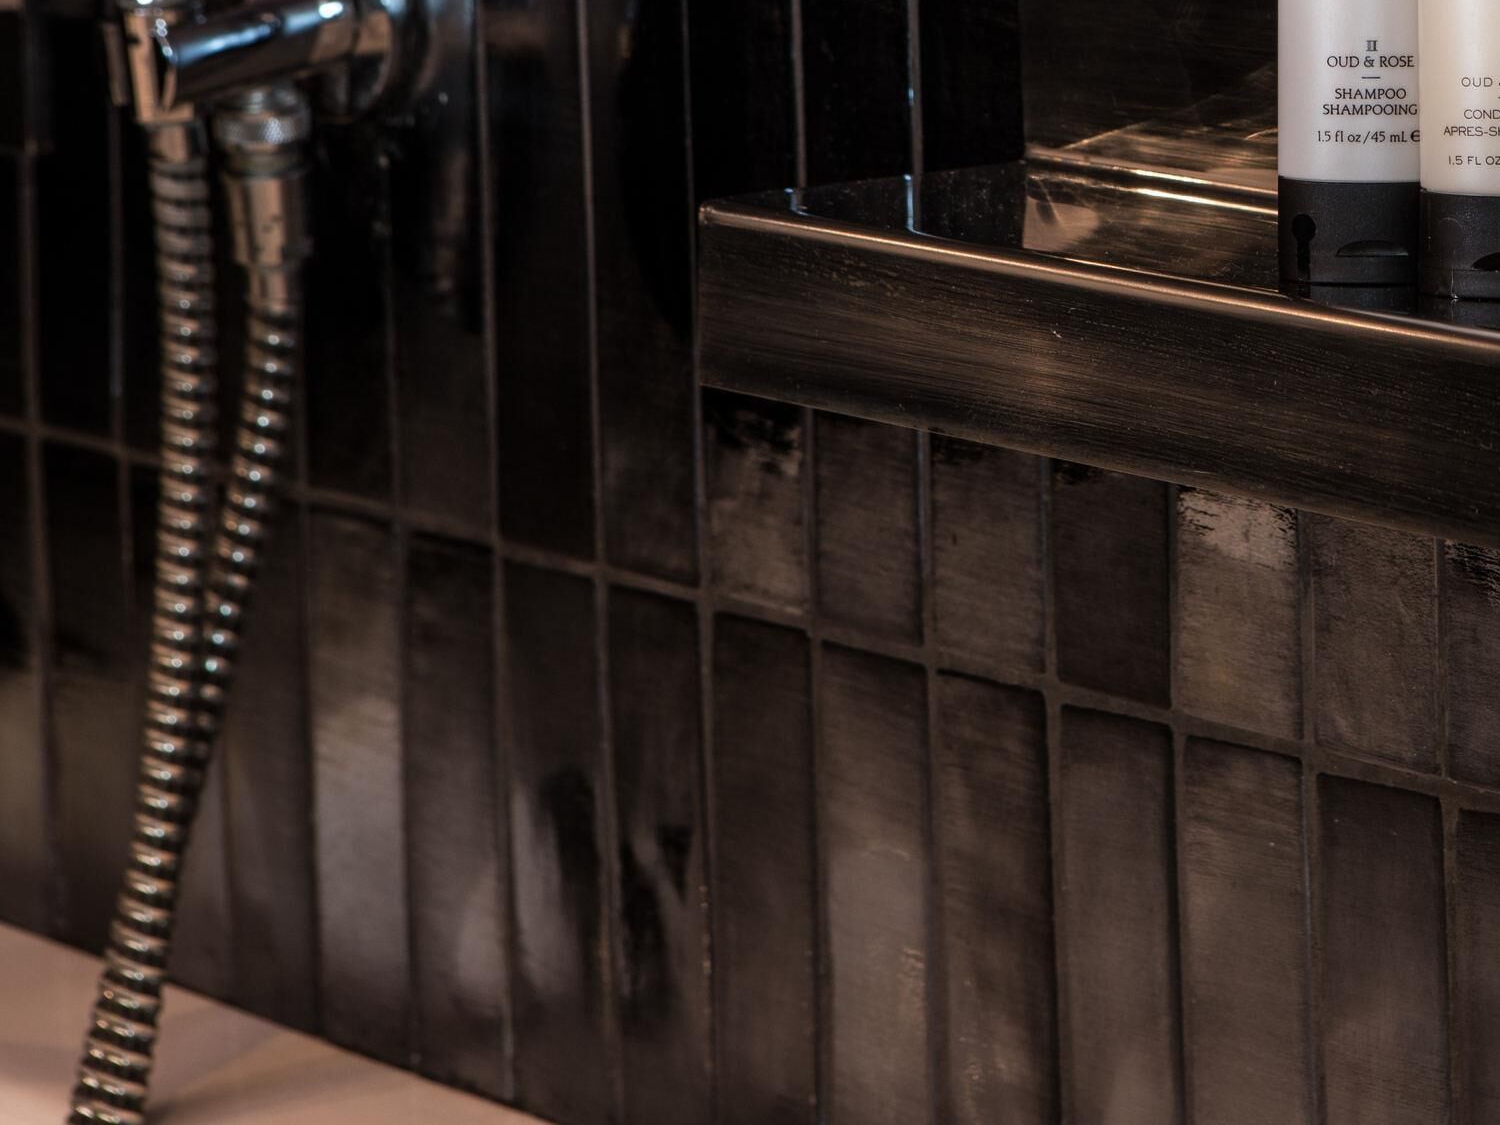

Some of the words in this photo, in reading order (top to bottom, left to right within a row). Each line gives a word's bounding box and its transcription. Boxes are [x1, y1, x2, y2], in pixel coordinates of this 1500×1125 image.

[1366, 40, 1378, 52] II
[1326, 56, 1360, 68] OUD
[1364, 56, 1376, 68] &
[1380, 56, 1415, 68] ROSE
[1461, 76, 1493, 88] OUD
[1334, 88, 1407, 100] SHAMPOO
[1322, 104, 1418, 116] SHAMPOOING
[1318, 130, 1332, 142] 1.5
[1335, 130, 1344, 142] fl
[1390, 131, 1408, 142] mL
[1448, 156, 1463, 166] 1.5
[1468, 156, 1482, 166] FL
